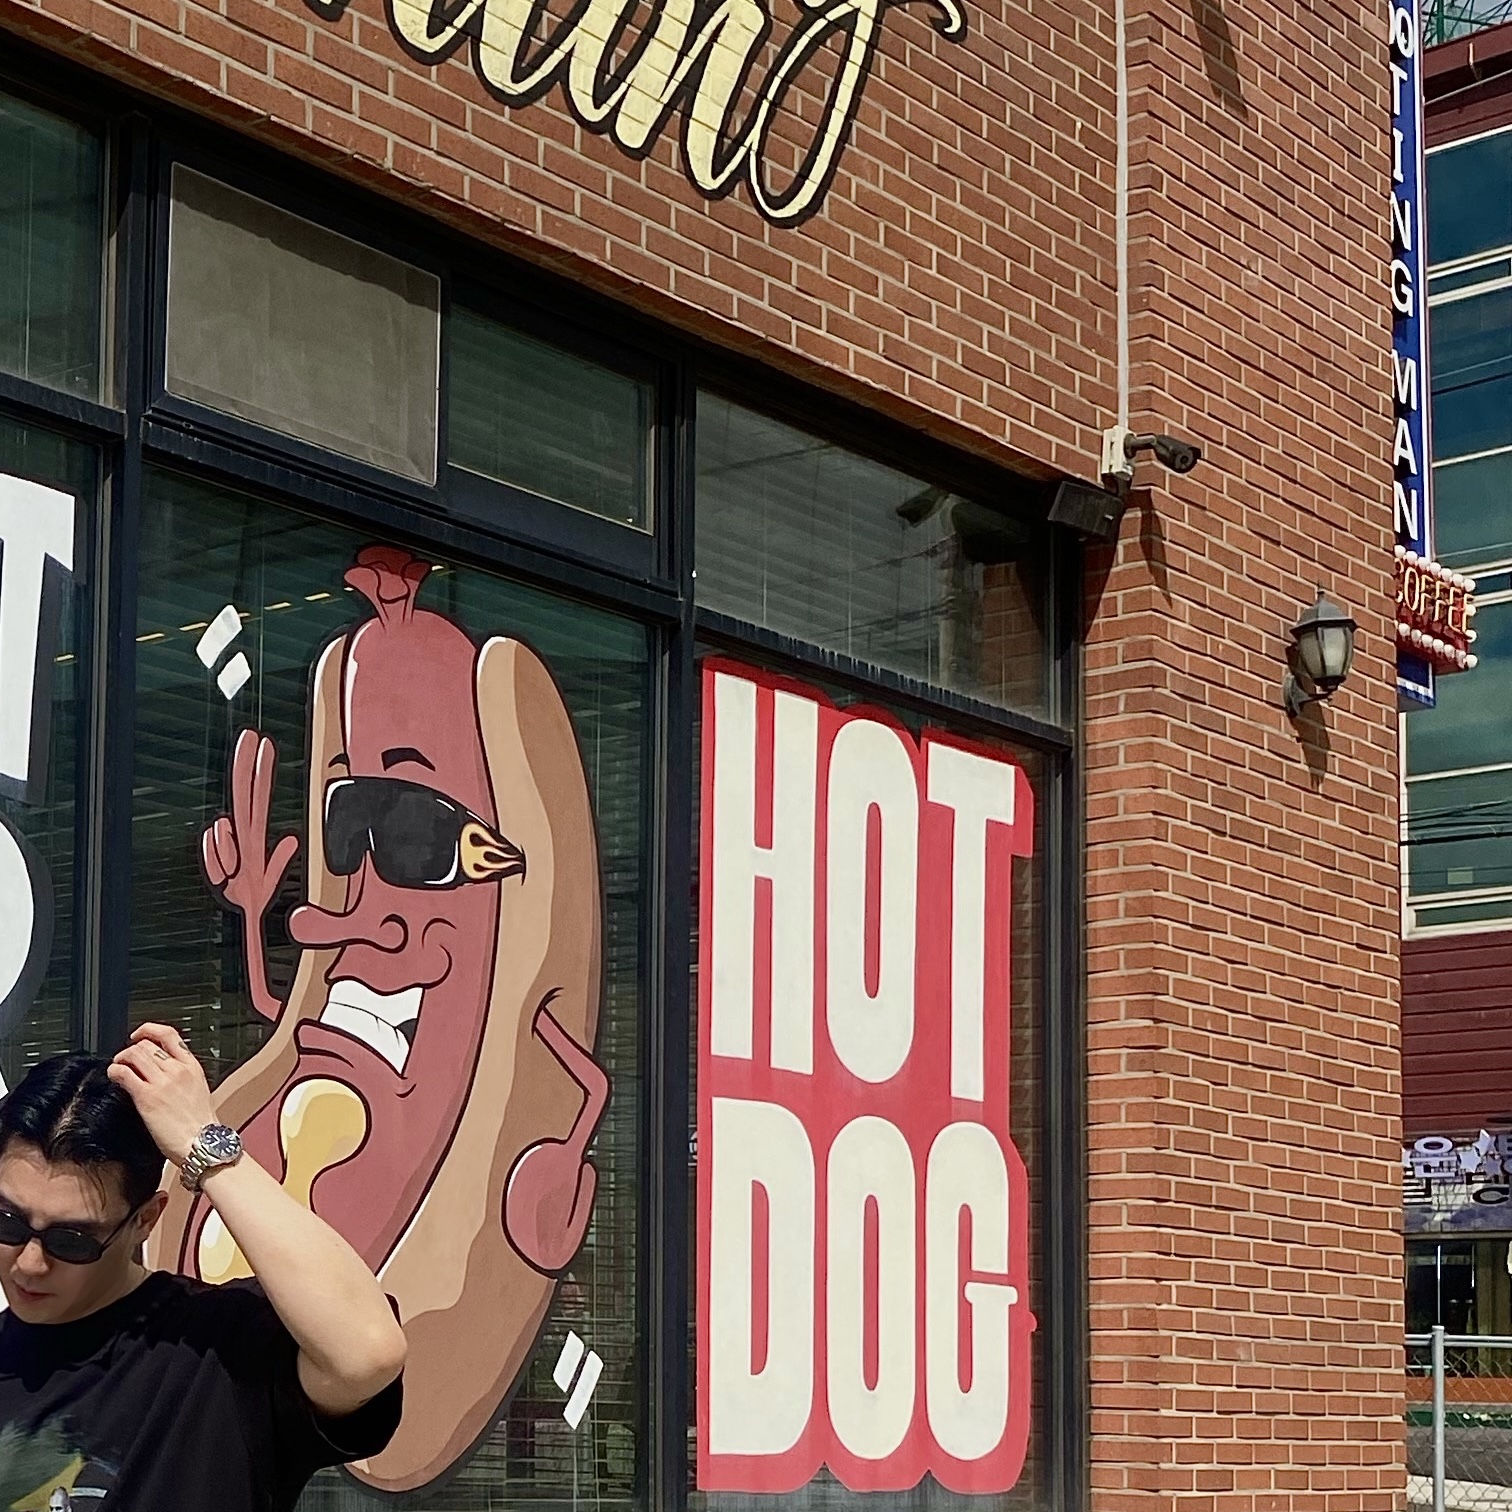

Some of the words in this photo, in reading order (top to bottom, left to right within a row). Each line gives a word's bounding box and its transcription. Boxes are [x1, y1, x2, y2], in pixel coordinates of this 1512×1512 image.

[1391, 348, 1419, 541] MAN
[710, 671, 1017, 1102] HOT
[708, 1097, 1018, 1461] DOG
